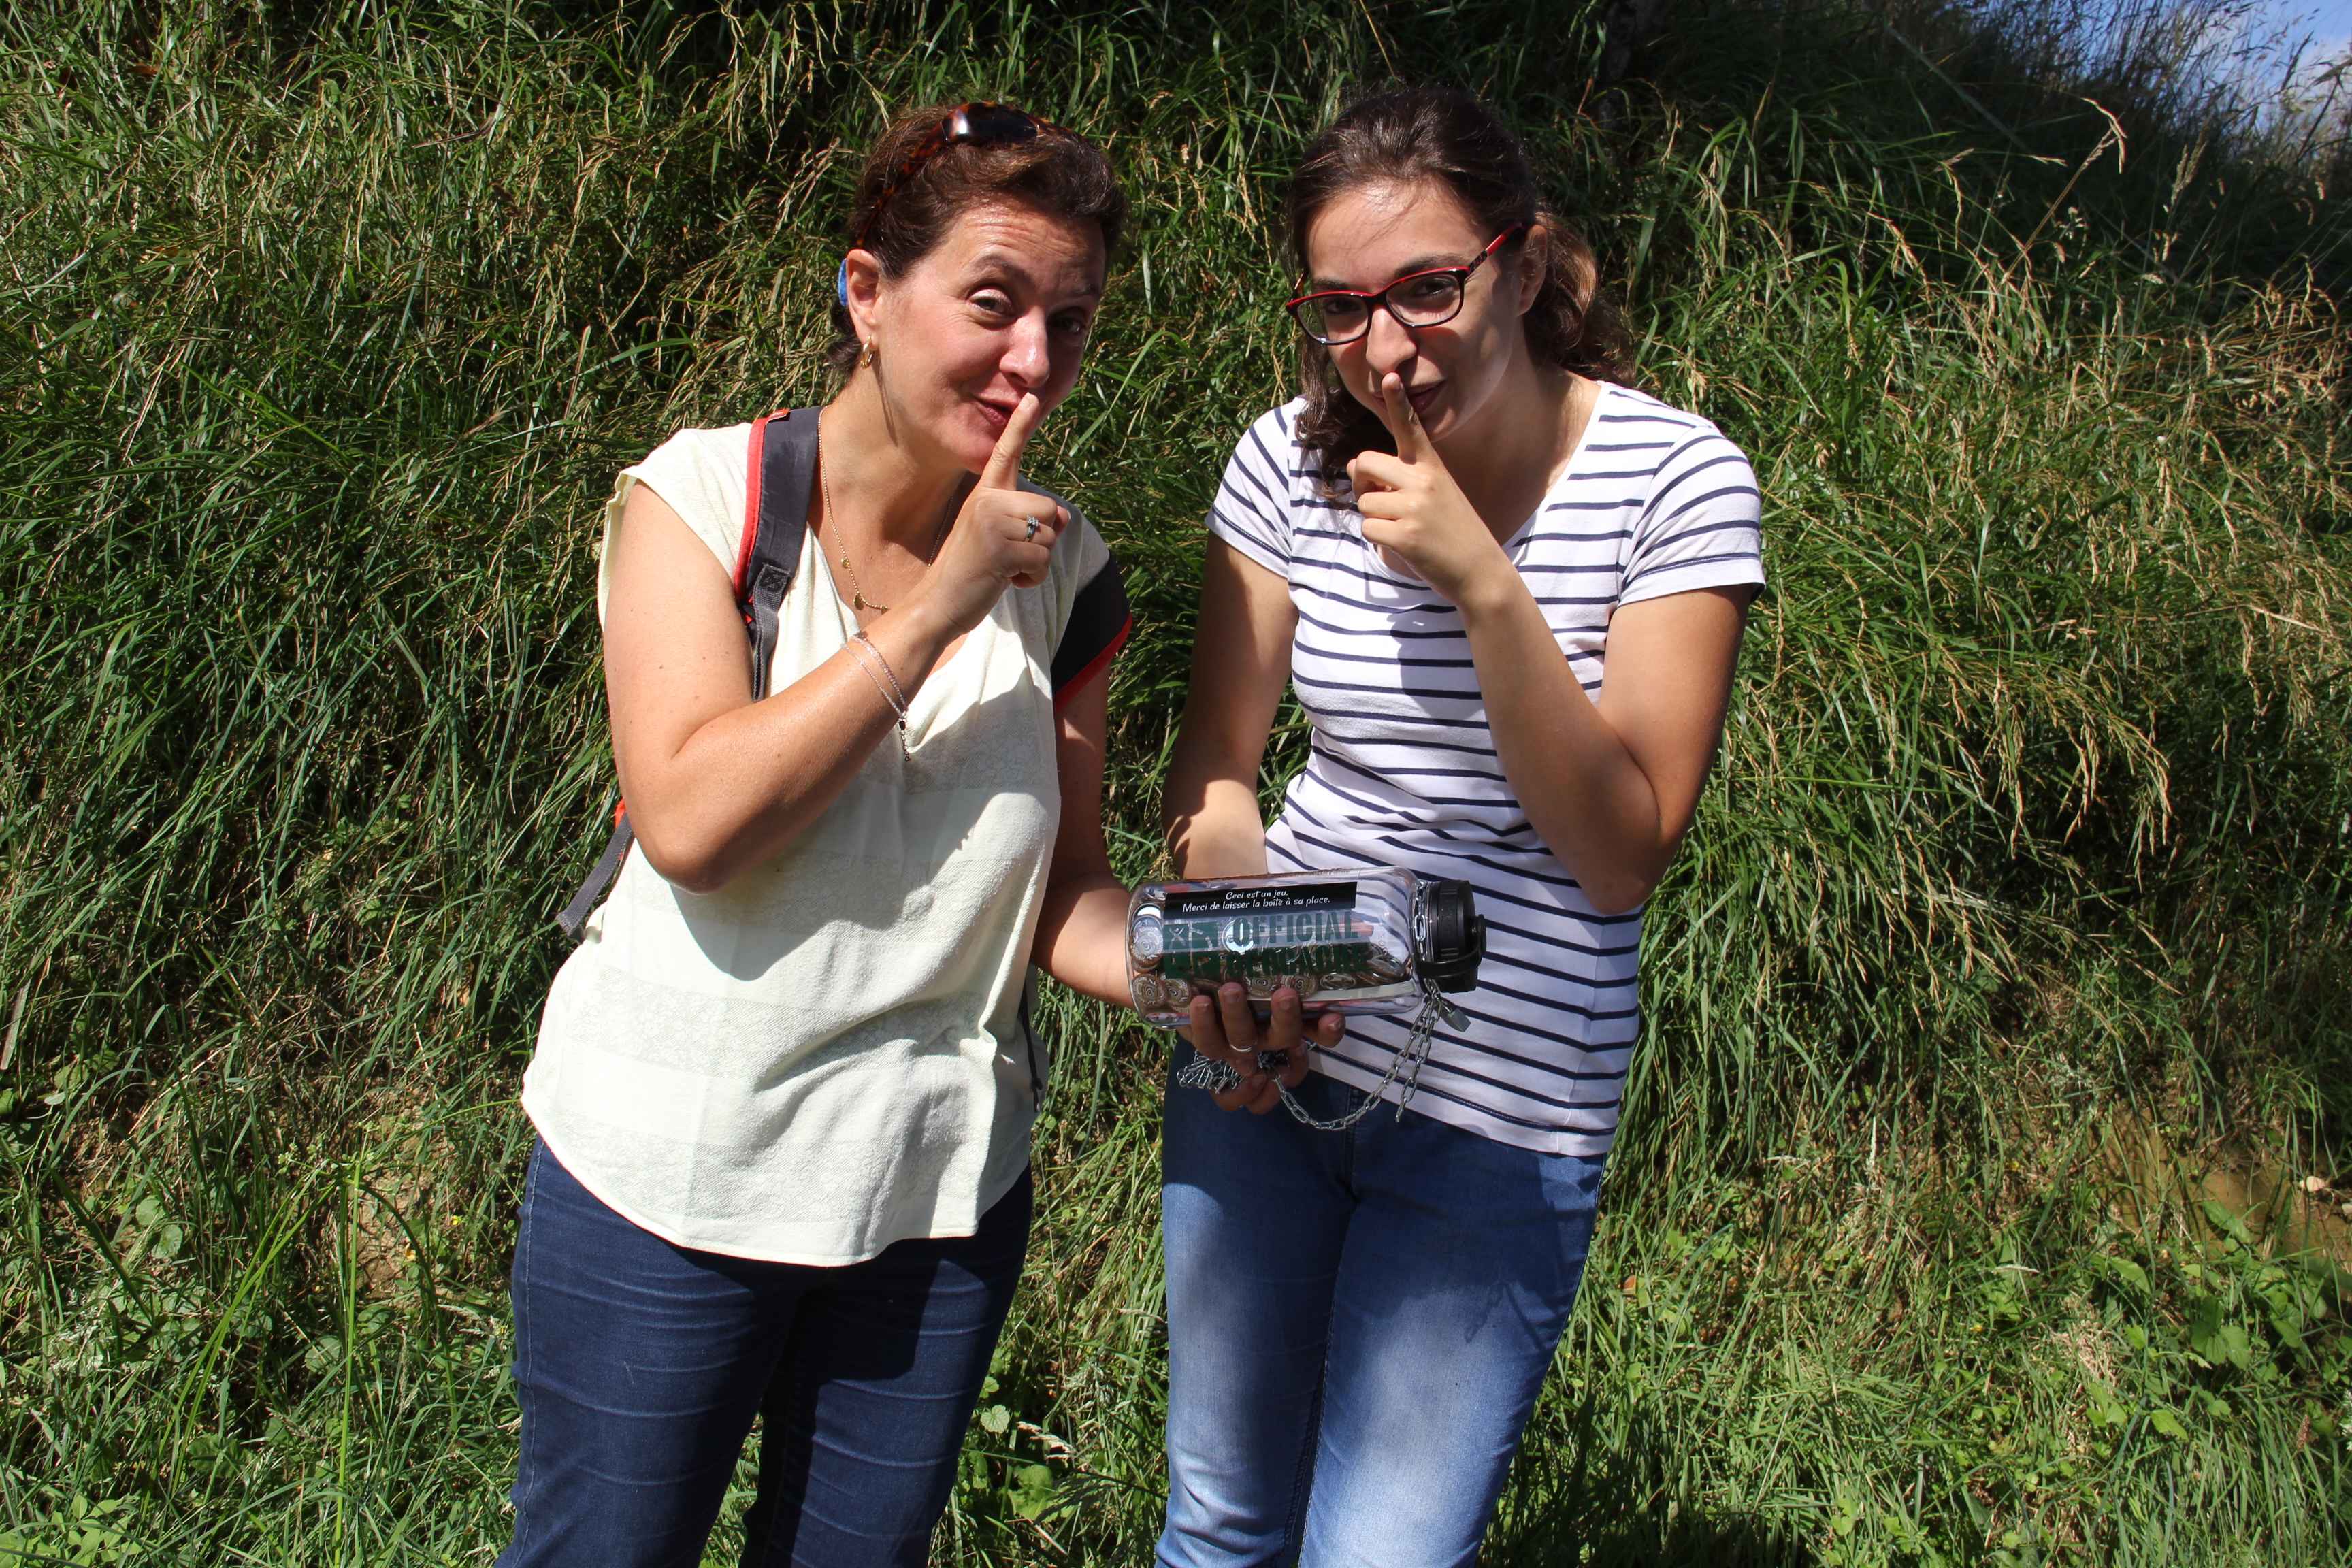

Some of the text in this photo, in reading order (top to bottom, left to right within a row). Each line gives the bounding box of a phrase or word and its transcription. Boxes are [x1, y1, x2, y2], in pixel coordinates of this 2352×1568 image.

[1226, 892, 1244, 900] Ceci
[1273, 889, 1288, 898] jeu.
[1182, 902, 1208, 913] Merci
[1209, 902, 1220, 910] de
[1223, 901, 1250, 910] laisser
[1253, 899, 1260, 907] la
[1286, 897, 1291, 905] à
[1305, 896, 1330, 907] place.
[1232, 911, 1358, 946] OFFICIAL
